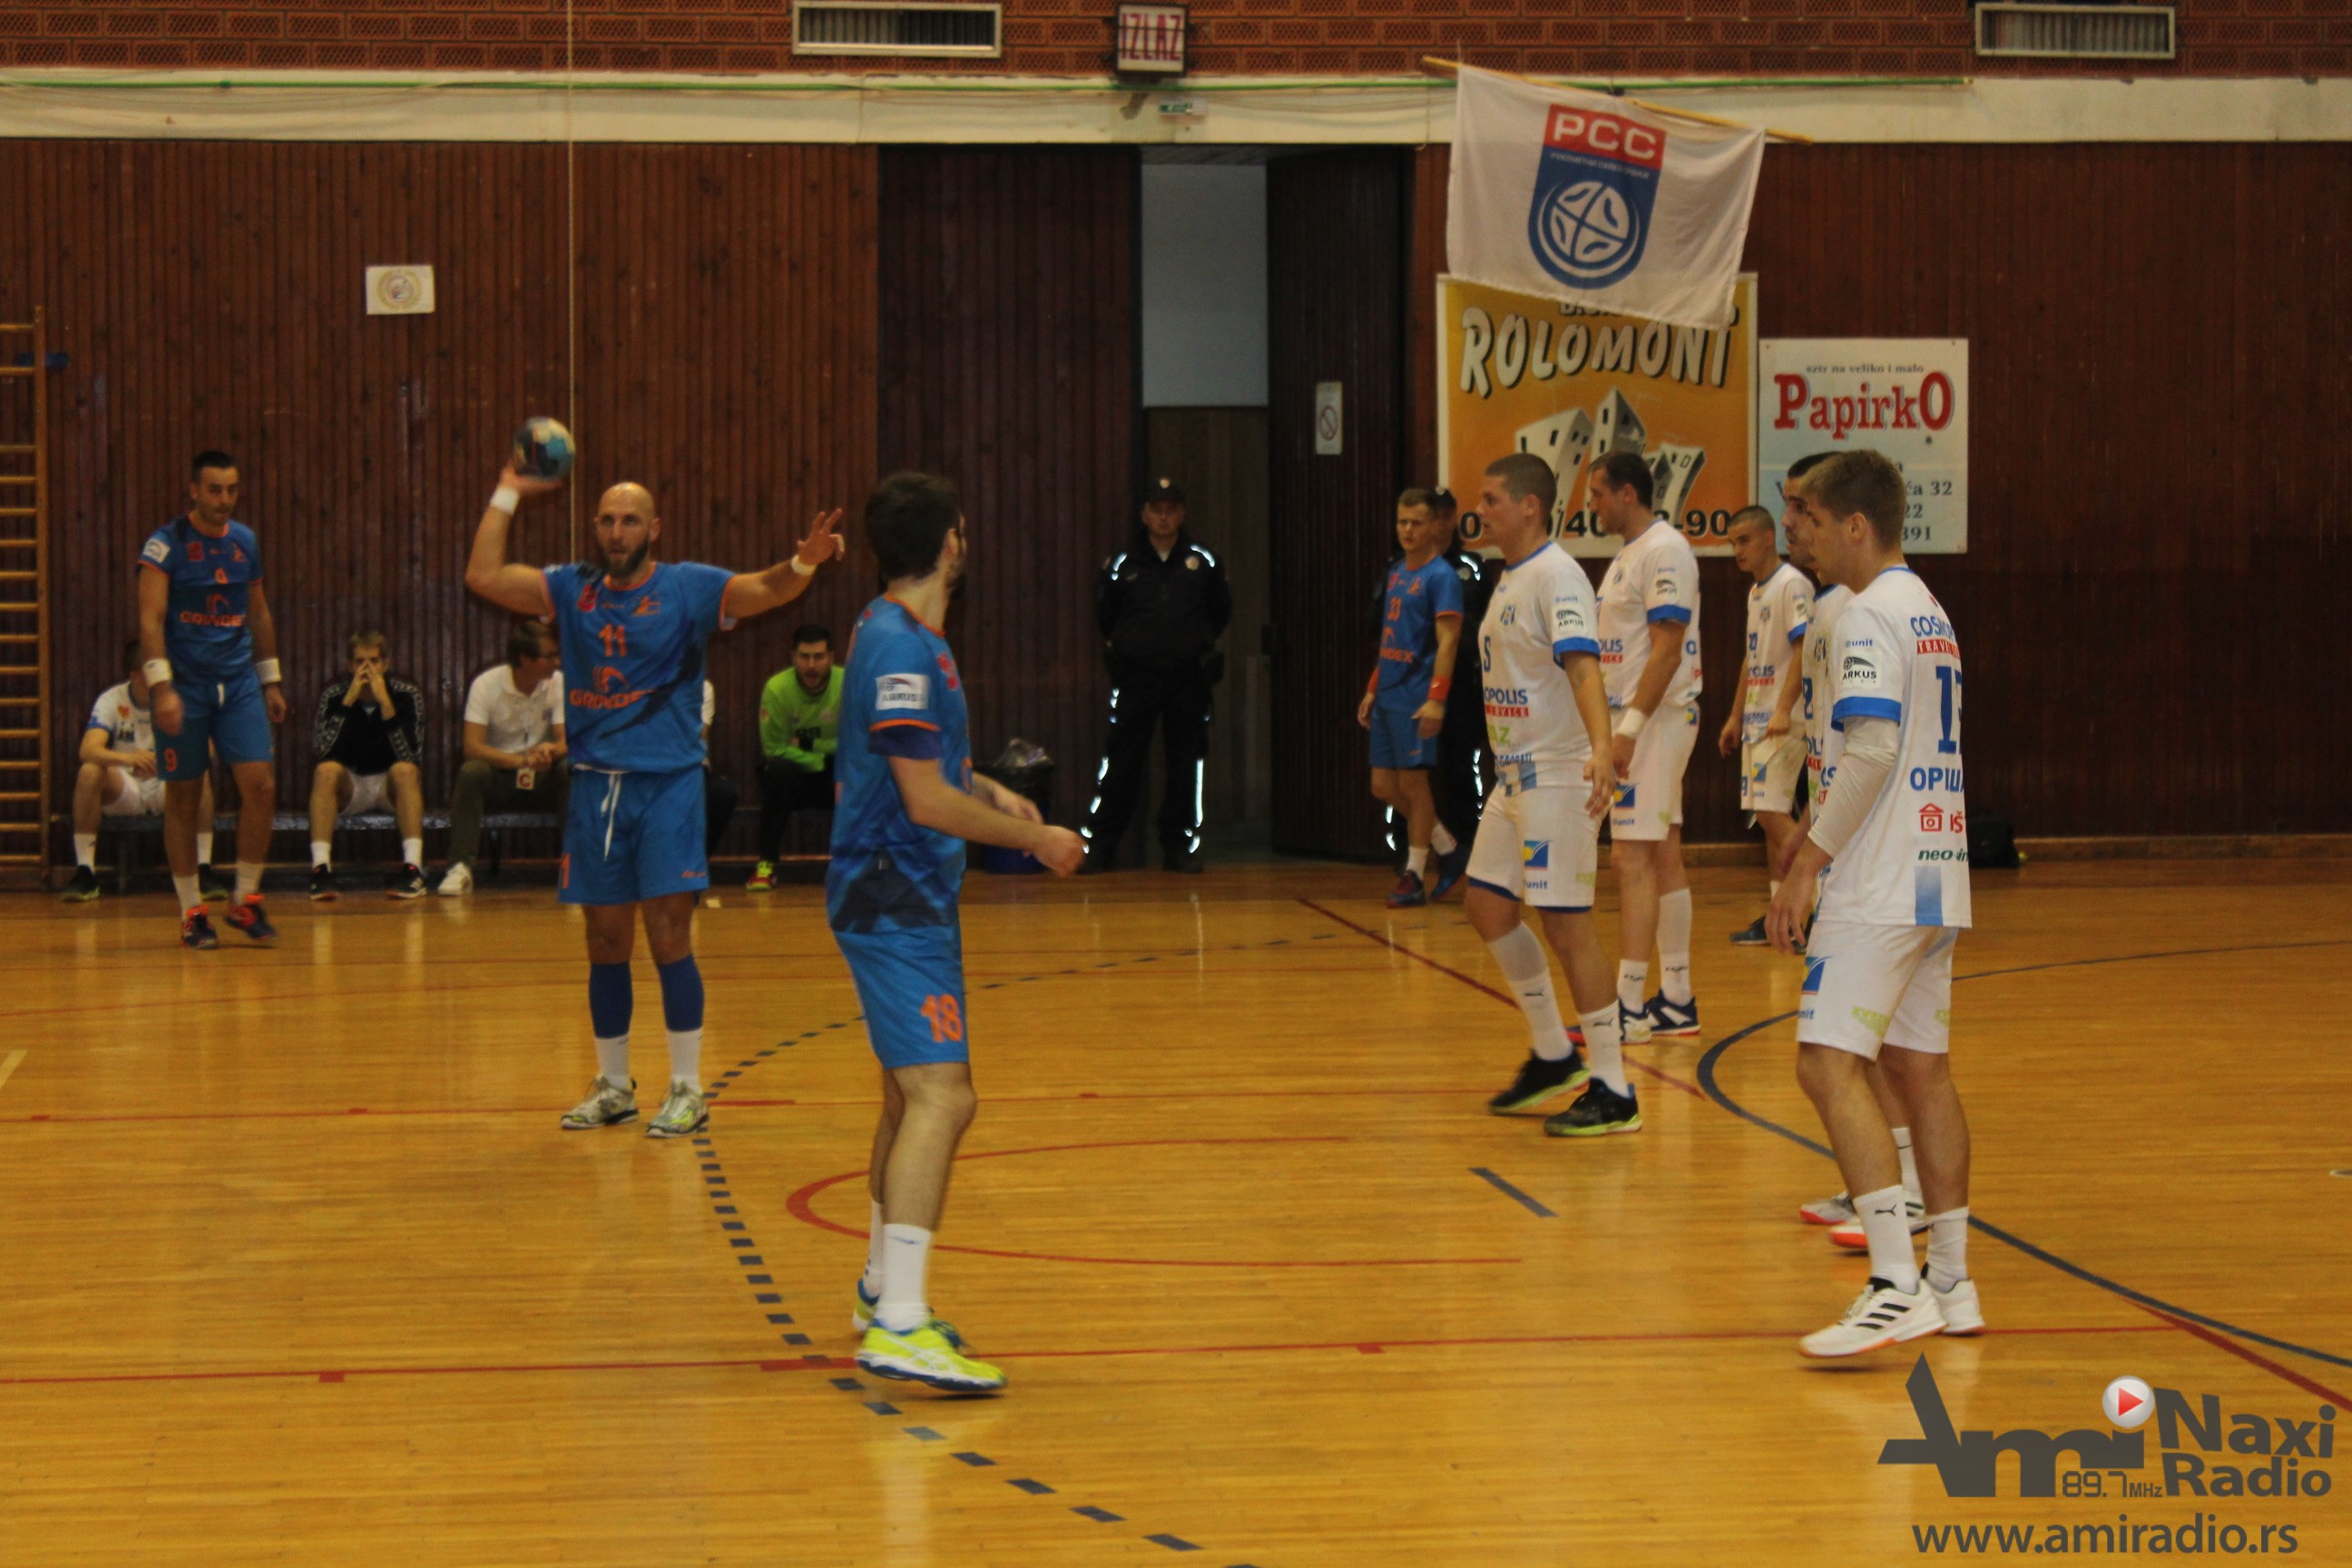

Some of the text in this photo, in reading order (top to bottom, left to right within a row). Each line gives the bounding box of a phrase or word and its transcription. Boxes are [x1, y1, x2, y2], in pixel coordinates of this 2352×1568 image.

[1122, 13, 1181, 62] IZLAZ
[1849, 364, 1885, 374] veliko
[1895, 364, 1925, 374] malo
[1929, 480, 1953, 496] 32
[599, 624, 627, 658] 11
[1842, 670, 1877, 681] ARKUS
[163, 747, 178, 772] 9
[519, 773, 533, 789] C
[920, 993, 963, 1044] 18
